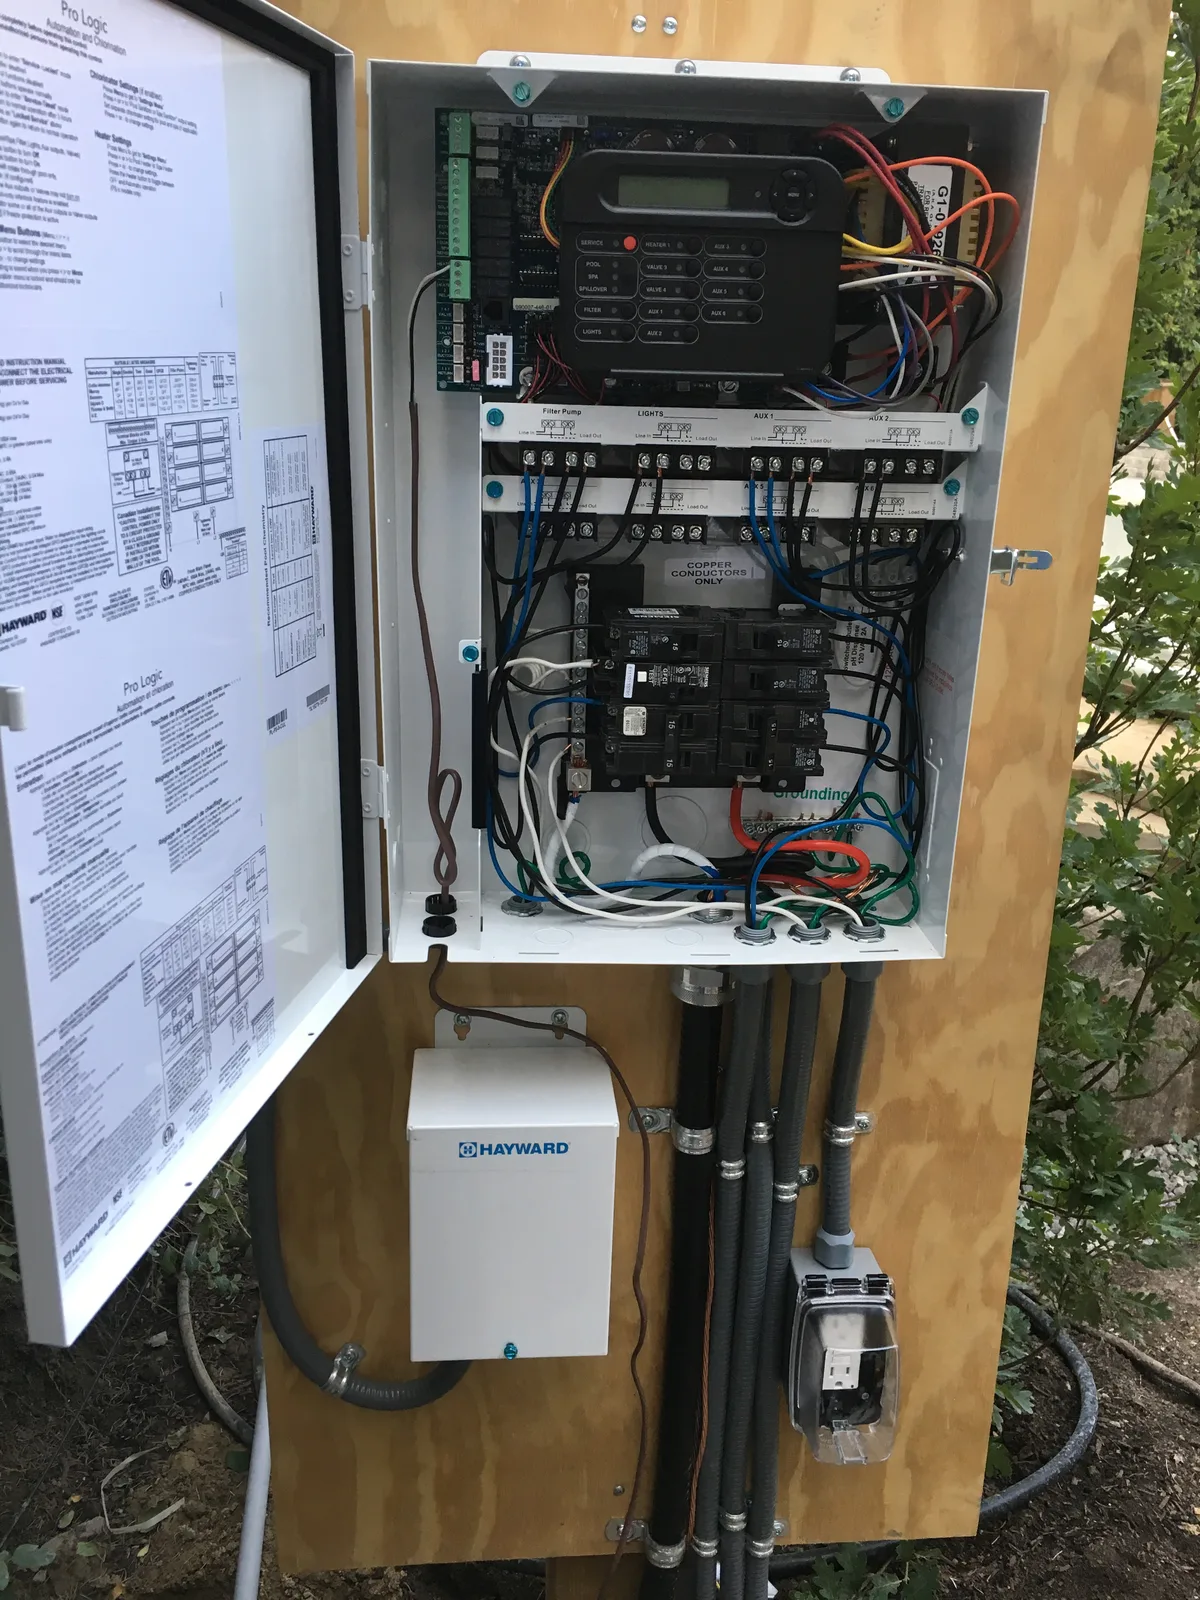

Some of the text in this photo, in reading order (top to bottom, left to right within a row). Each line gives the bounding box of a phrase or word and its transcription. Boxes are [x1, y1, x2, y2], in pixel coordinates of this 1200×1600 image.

[61, 0, 109, 35] Pro Logic
[46, 17, 81, 39] Automation
[17, 225, 41, 237] Buttons
[645, 241, 667, 249] HEATER
[15, 378, 37, 386] BEFORE
[671, 570, 748, 578] CONDUCTORS
[1, 608, 48, 634] HAYWARD
[860, 626, 868, 637] 2A
[672, 642, 679, 651] 15
[777, 639, 783, 648] 15
[123, 669, 163, 696] Pro Logic
[773, 681, 780, 689] 15
[668, 720, 676, 730] 15
[667, 759, 674, 768] 15
[773, 787, 850, 804] Grounding
[480, 1142, 569, 1156] HAYWARD
[72, 1210, 109, 1257] HAYWARD
